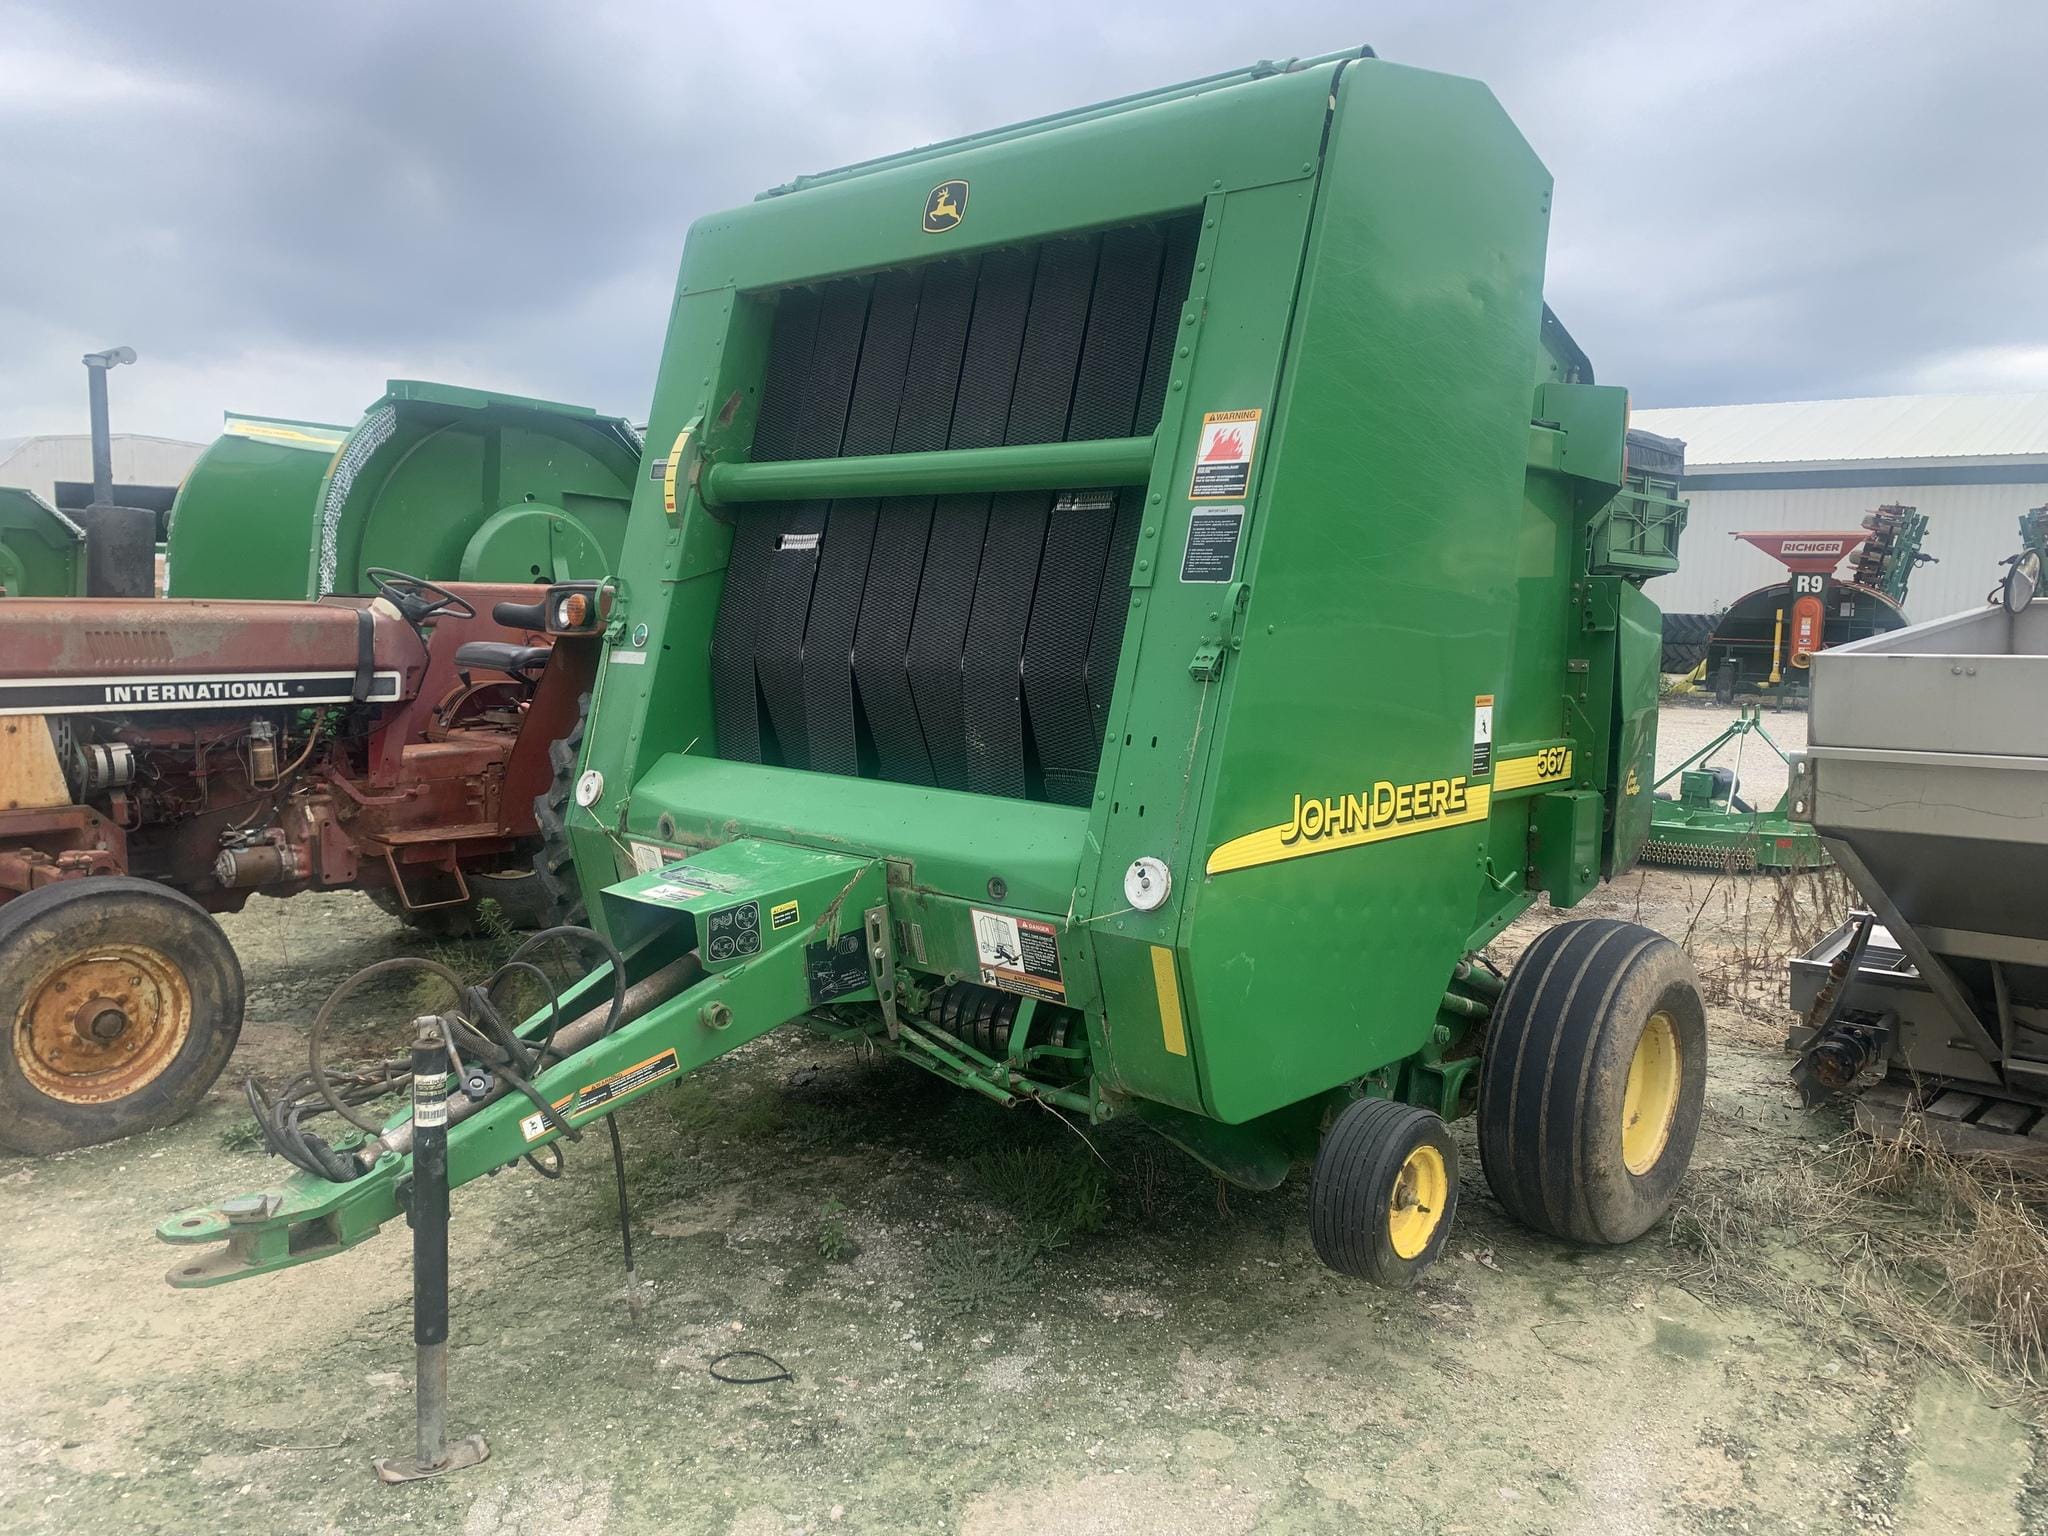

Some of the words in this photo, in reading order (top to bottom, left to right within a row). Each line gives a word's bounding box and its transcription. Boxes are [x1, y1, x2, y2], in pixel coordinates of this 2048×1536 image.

[1216, 410, 1256, 421] WARNING
[1783, 543, 1840, 552] RICHIGER
[1797, 575, 1823, 593] R9
[104, 682, 289, 703] INTERNATIONAL
[1537, 746, 1567, 777] 567
[1280, 792, 1369, 845] JOHN
[1372, 776, 1467, 828] DEERE
